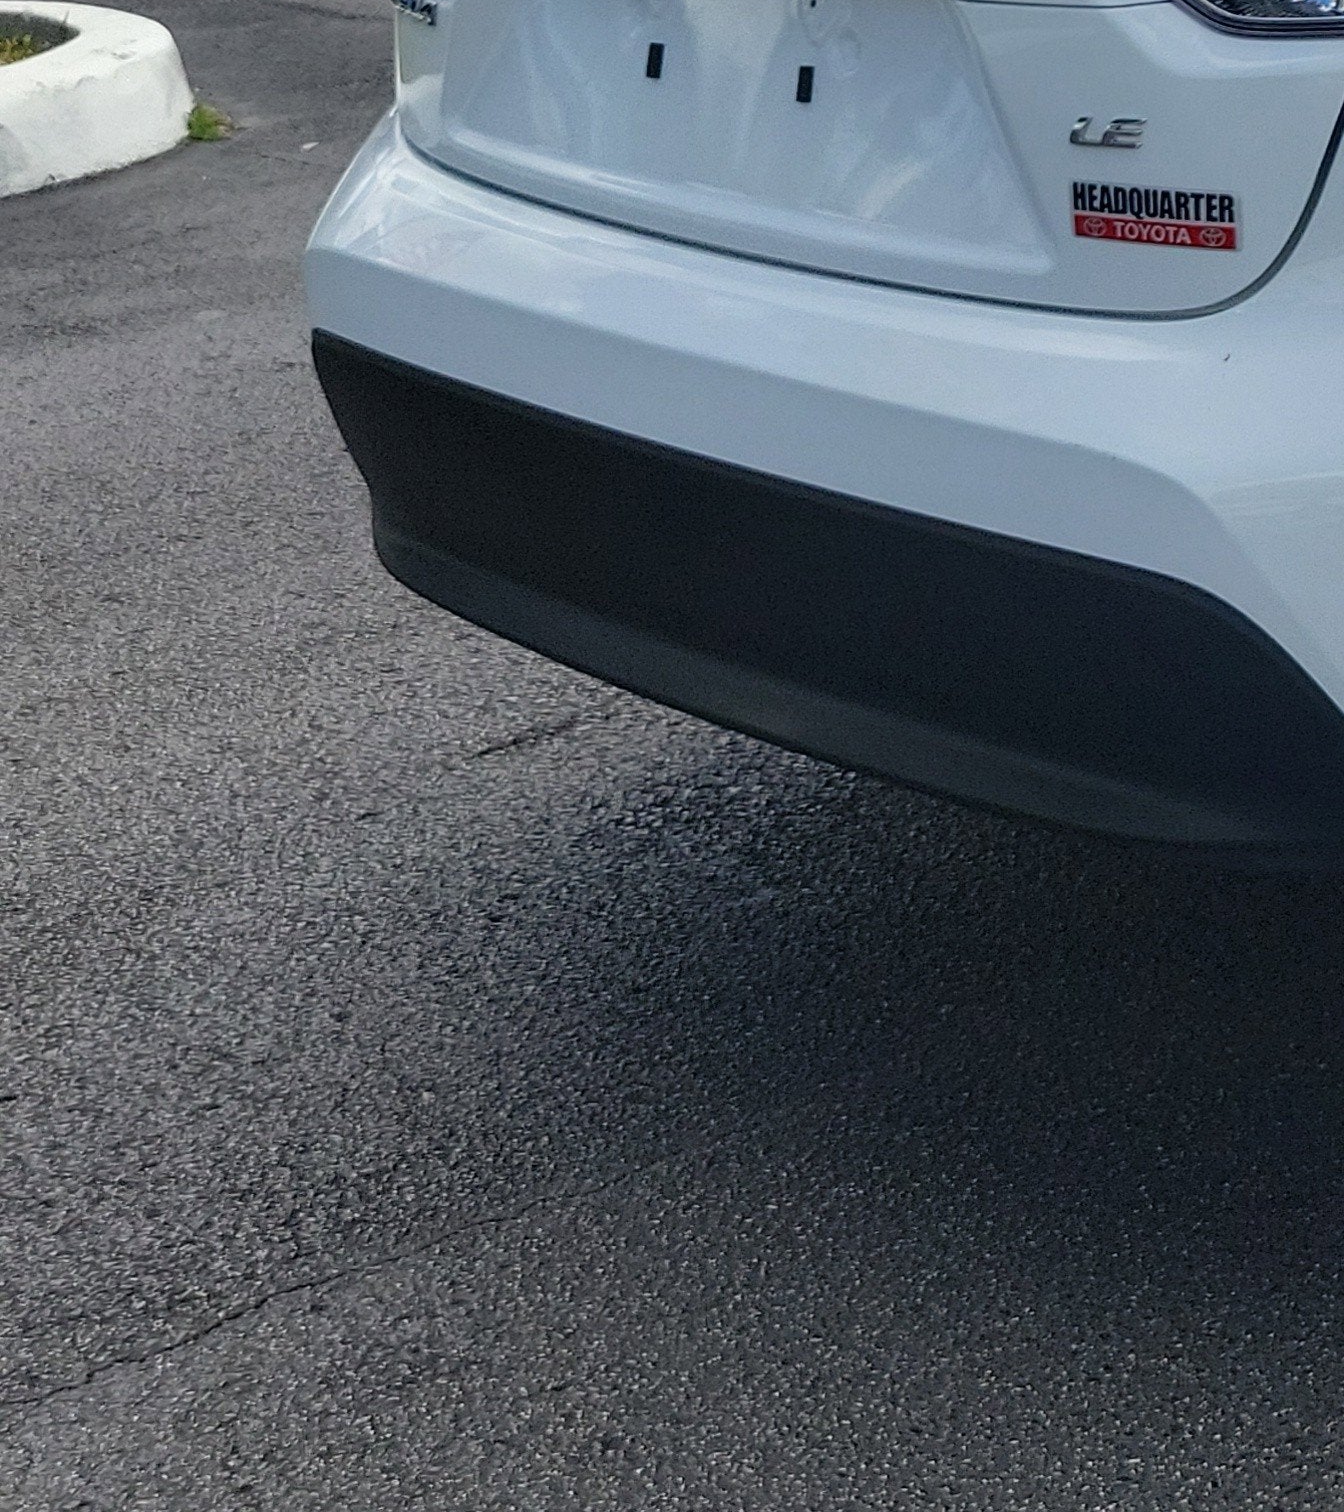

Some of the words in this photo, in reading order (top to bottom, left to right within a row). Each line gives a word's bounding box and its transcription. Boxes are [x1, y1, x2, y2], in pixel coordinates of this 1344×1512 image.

[1069, 116, 1148, 150] LE
[1072, 181, 1235, 223] HEADQUARTER
[1113, 221, 1192, 245] TOYOTA
